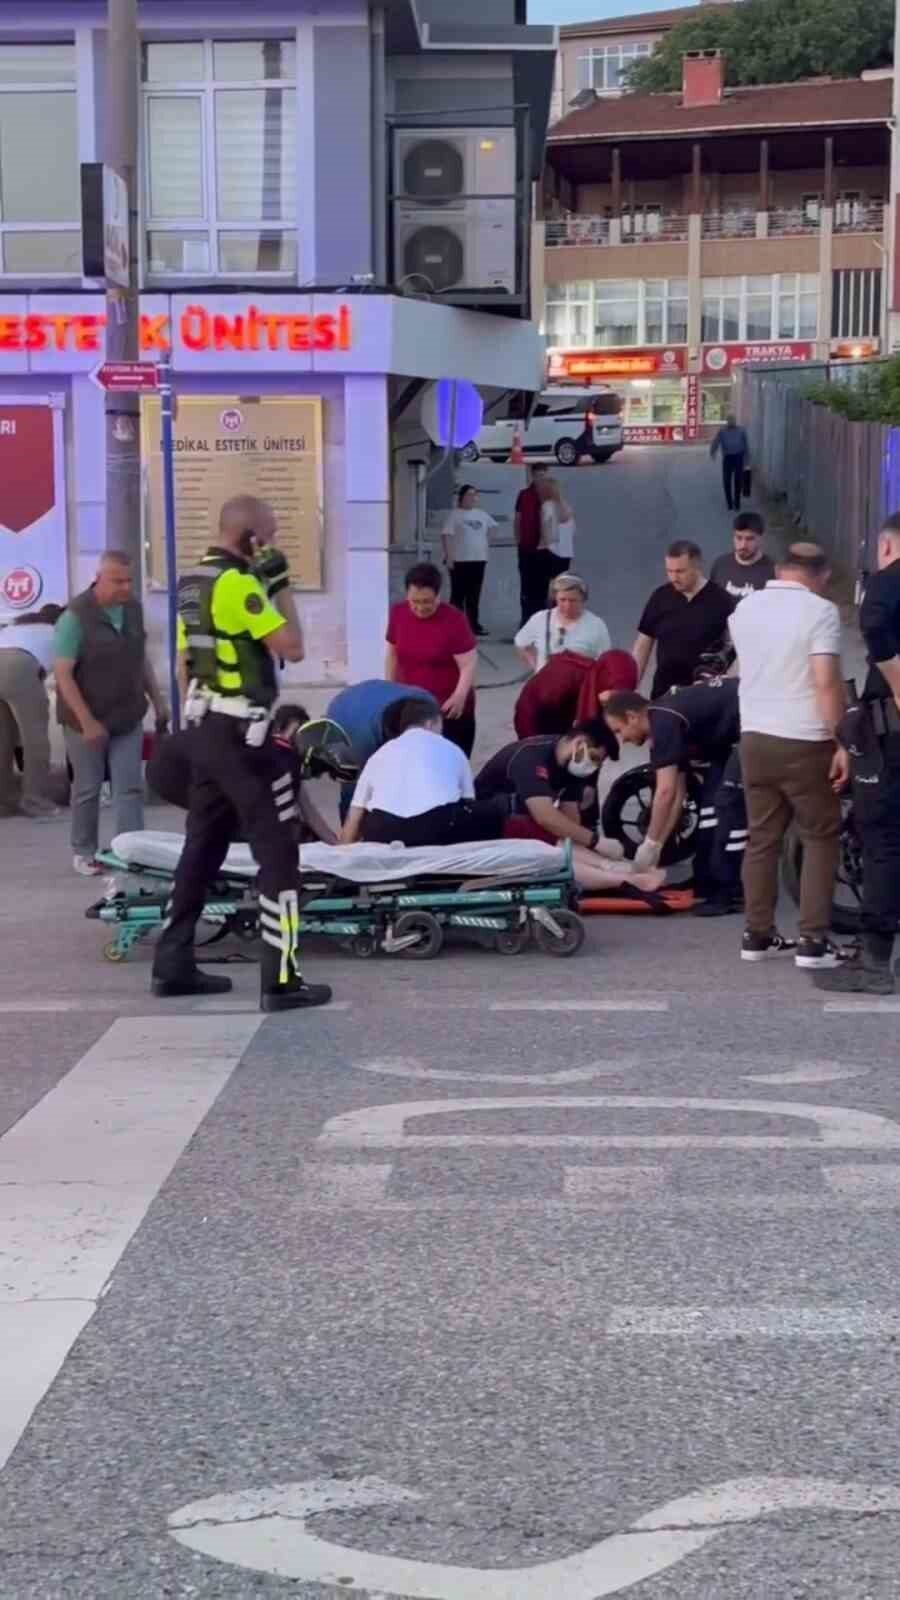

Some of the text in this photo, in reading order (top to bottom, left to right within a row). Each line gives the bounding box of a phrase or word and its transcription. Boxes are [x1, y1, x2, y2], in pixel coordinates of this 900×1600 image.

[0, 304, 350, 352] ESTEK ÜNİTESİ
[744, 346, 793, 357] TRAKYA
[215, 436, 257, 452] ESTETİK
[264, 435, 305, 451] ÜNİTESİ
